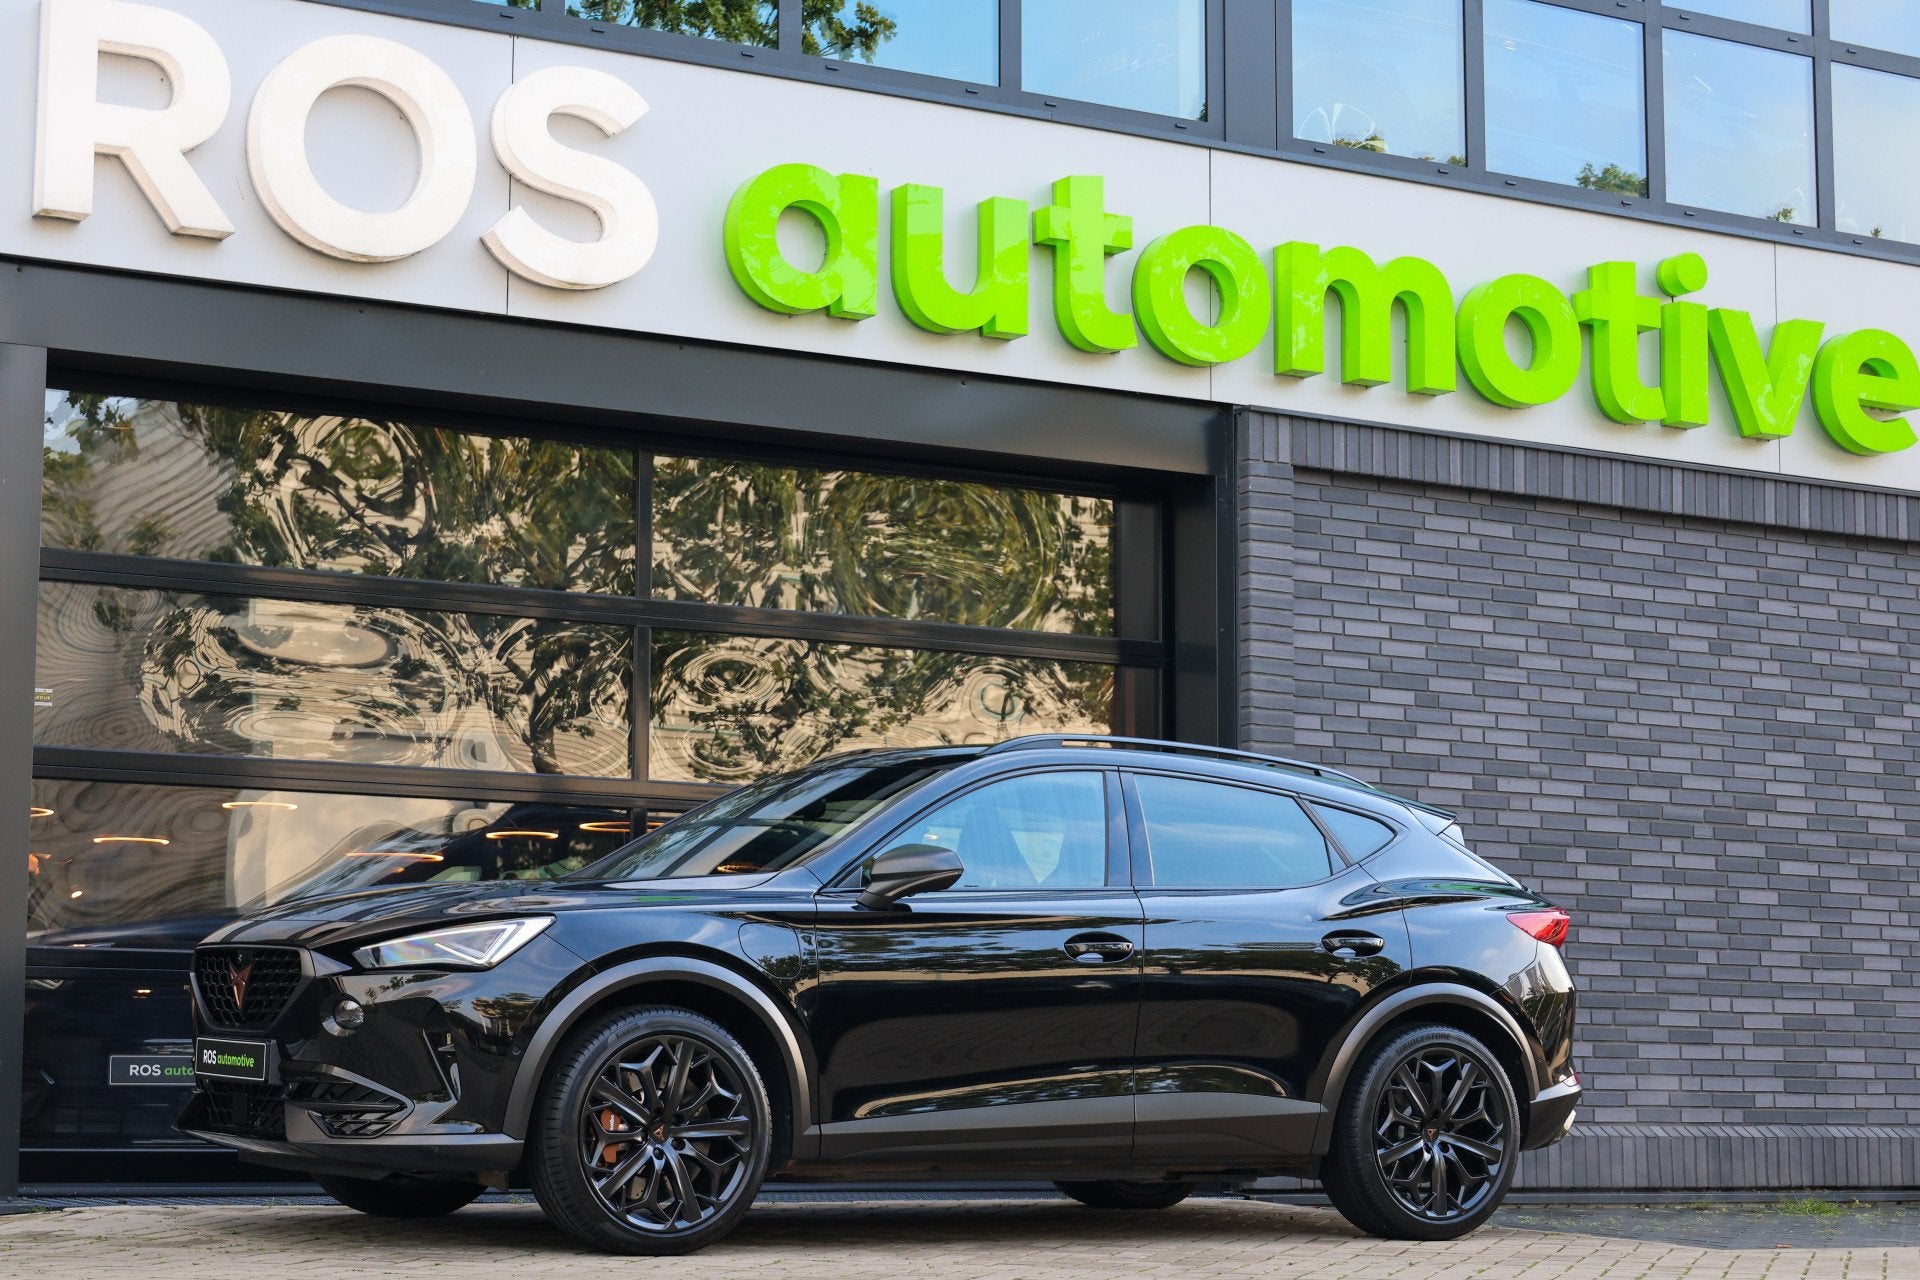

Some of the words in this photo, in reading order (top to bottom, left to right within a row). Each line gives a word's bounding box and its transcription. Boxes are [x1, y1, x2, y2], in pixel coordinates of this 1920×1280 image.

[32, 0, 660, 290] ROS
[723, 163, 1920, 456] automotive
[203, 1050, 216, 1064] ROS
[218, 1054, 254, 1067] automotive
[129, 1064, 161, 1076] ROS
